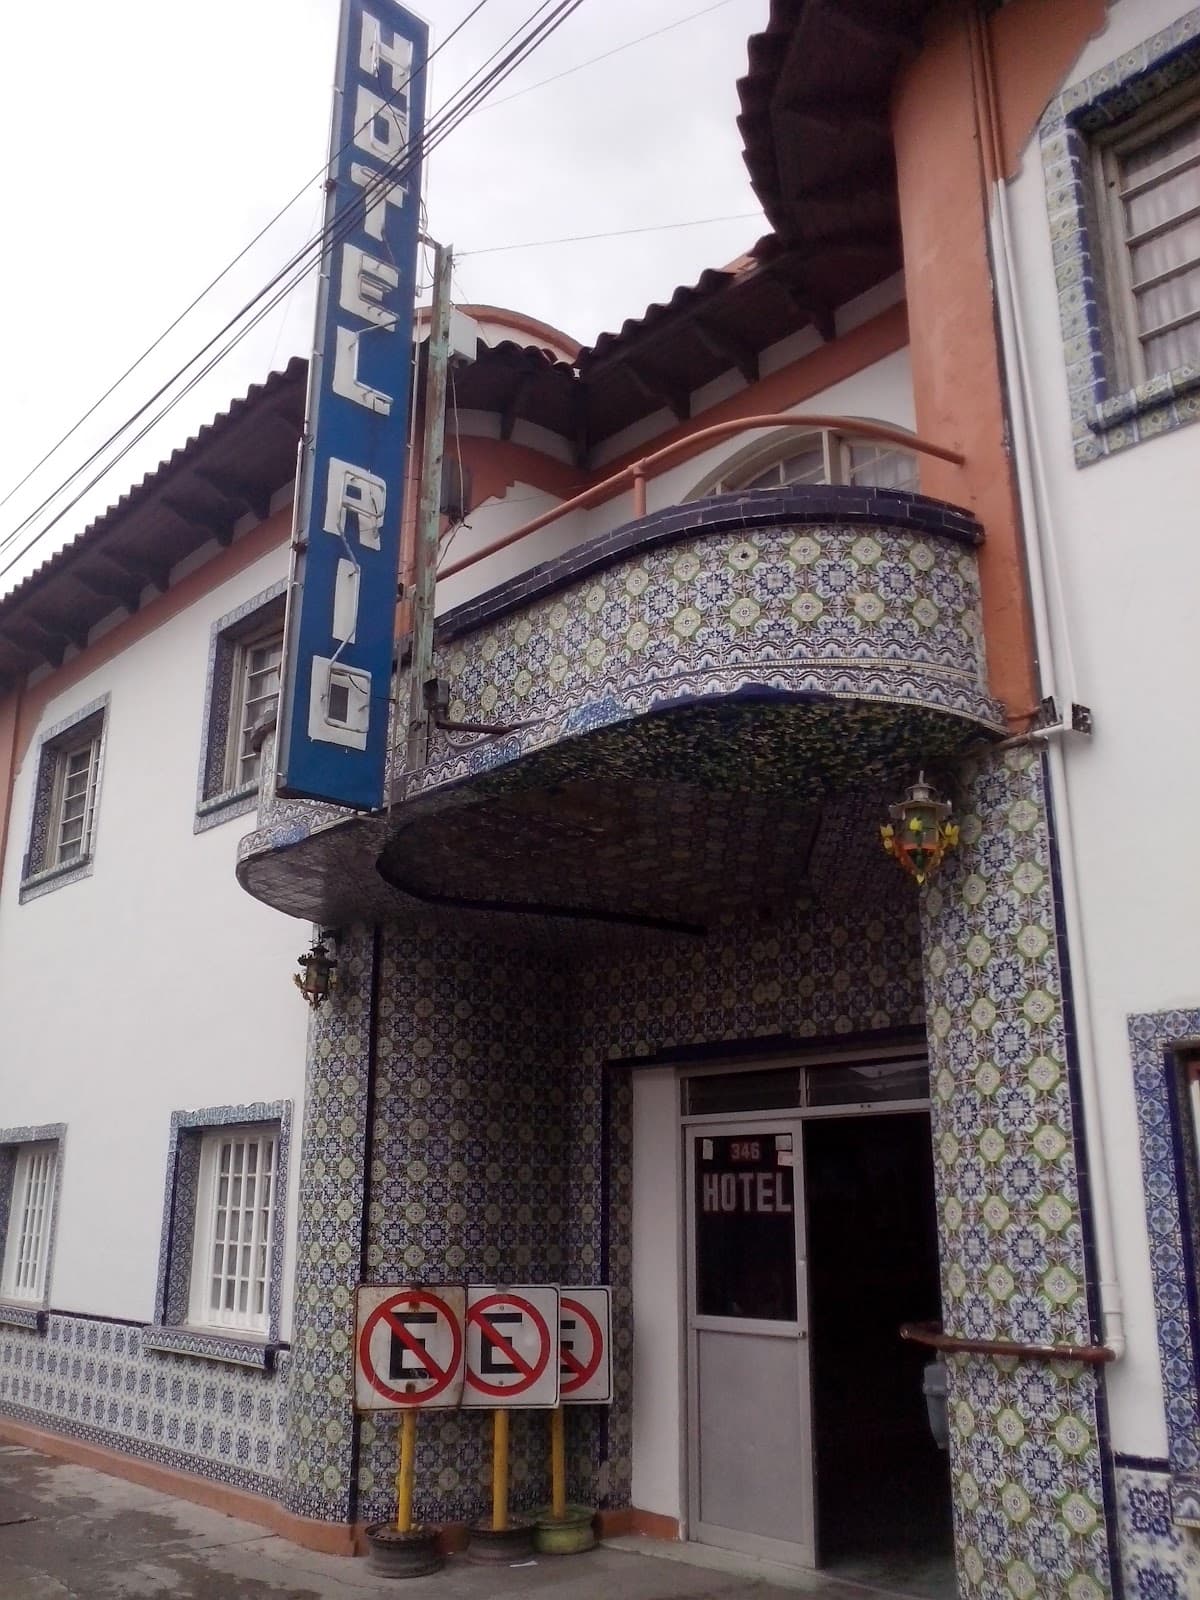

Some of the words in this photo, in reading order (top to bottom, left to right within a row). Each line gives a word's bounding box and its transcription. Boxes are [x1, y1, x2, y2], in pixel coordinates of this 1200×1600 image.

[332, 10, 413, 416] HOTEL
[307, 457, 387, 751] RIO
[702, 1171, 792, 1212] HOTEL
[389, 1311, 438, 1380] E
[480, 1312, 523, 1374] E
